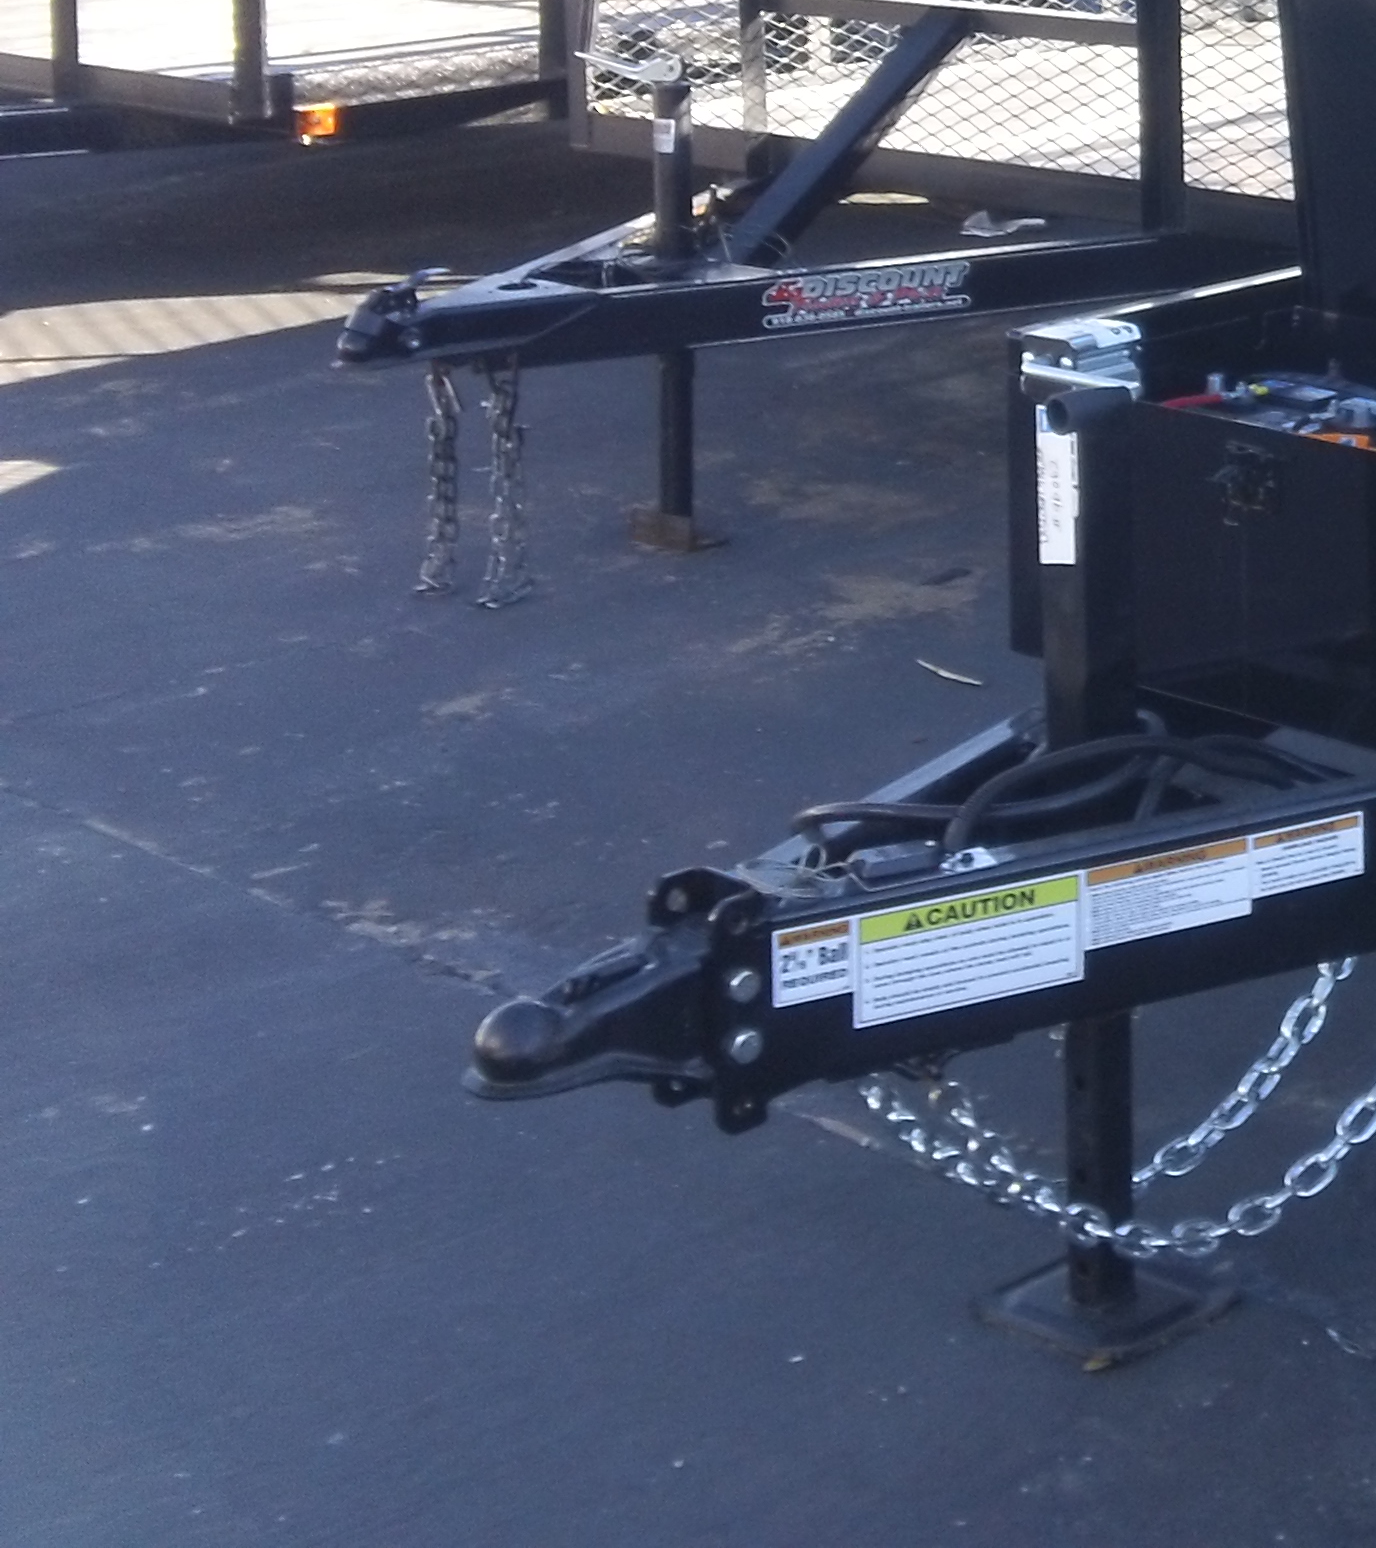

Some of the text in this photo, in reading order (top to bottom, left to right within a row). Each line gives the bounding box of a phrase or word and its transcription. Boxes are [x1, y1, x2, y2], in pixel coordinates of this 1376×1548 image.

[803, 261, 970, 297] DISCOUNT
[926, 889, 1036, 926] CAUTION
[783, 968, 847, 988] REQUIRED
